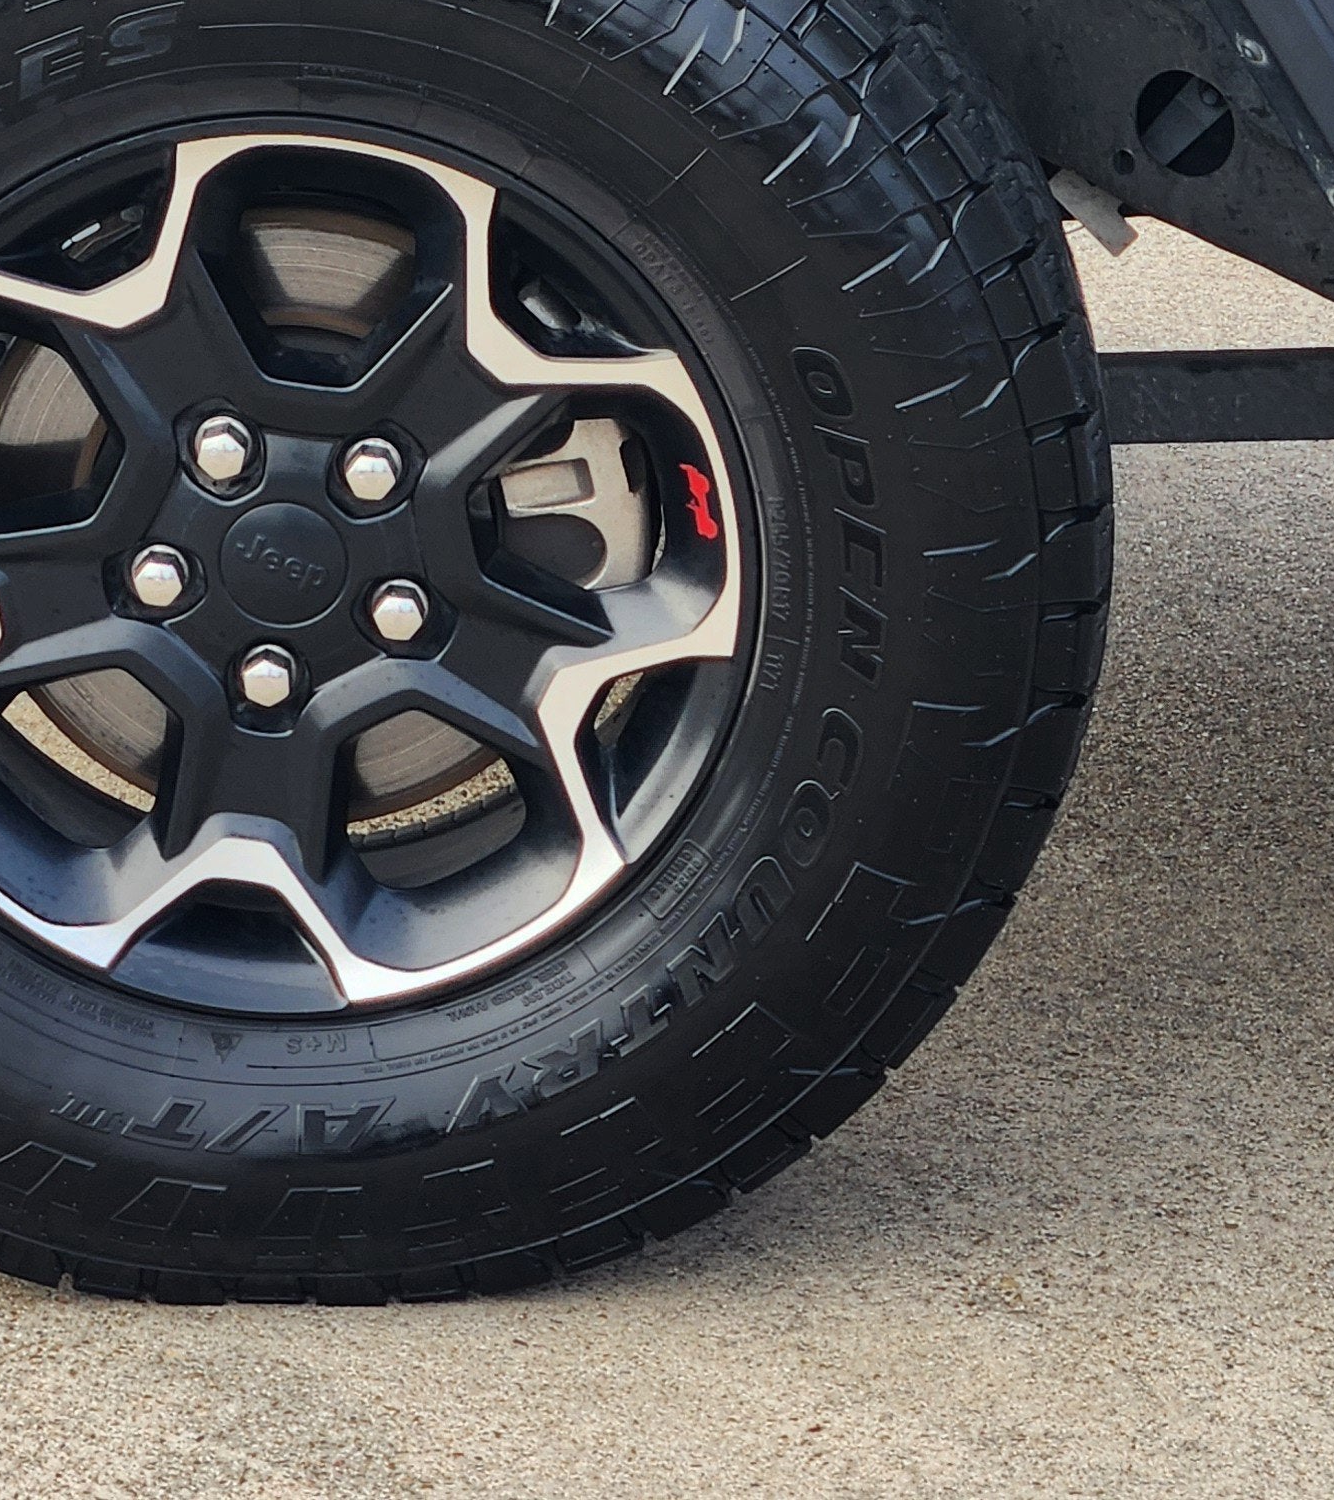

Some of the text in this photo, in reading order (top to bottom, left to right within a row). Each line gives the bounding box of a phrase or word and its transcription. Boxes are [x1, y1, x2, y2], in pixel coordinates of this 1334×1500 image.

[235, 532, 329, 591] Jeep
[790, 346, 890, 690] OPEN
[445, 707, 866, 1136] COUNTRY
